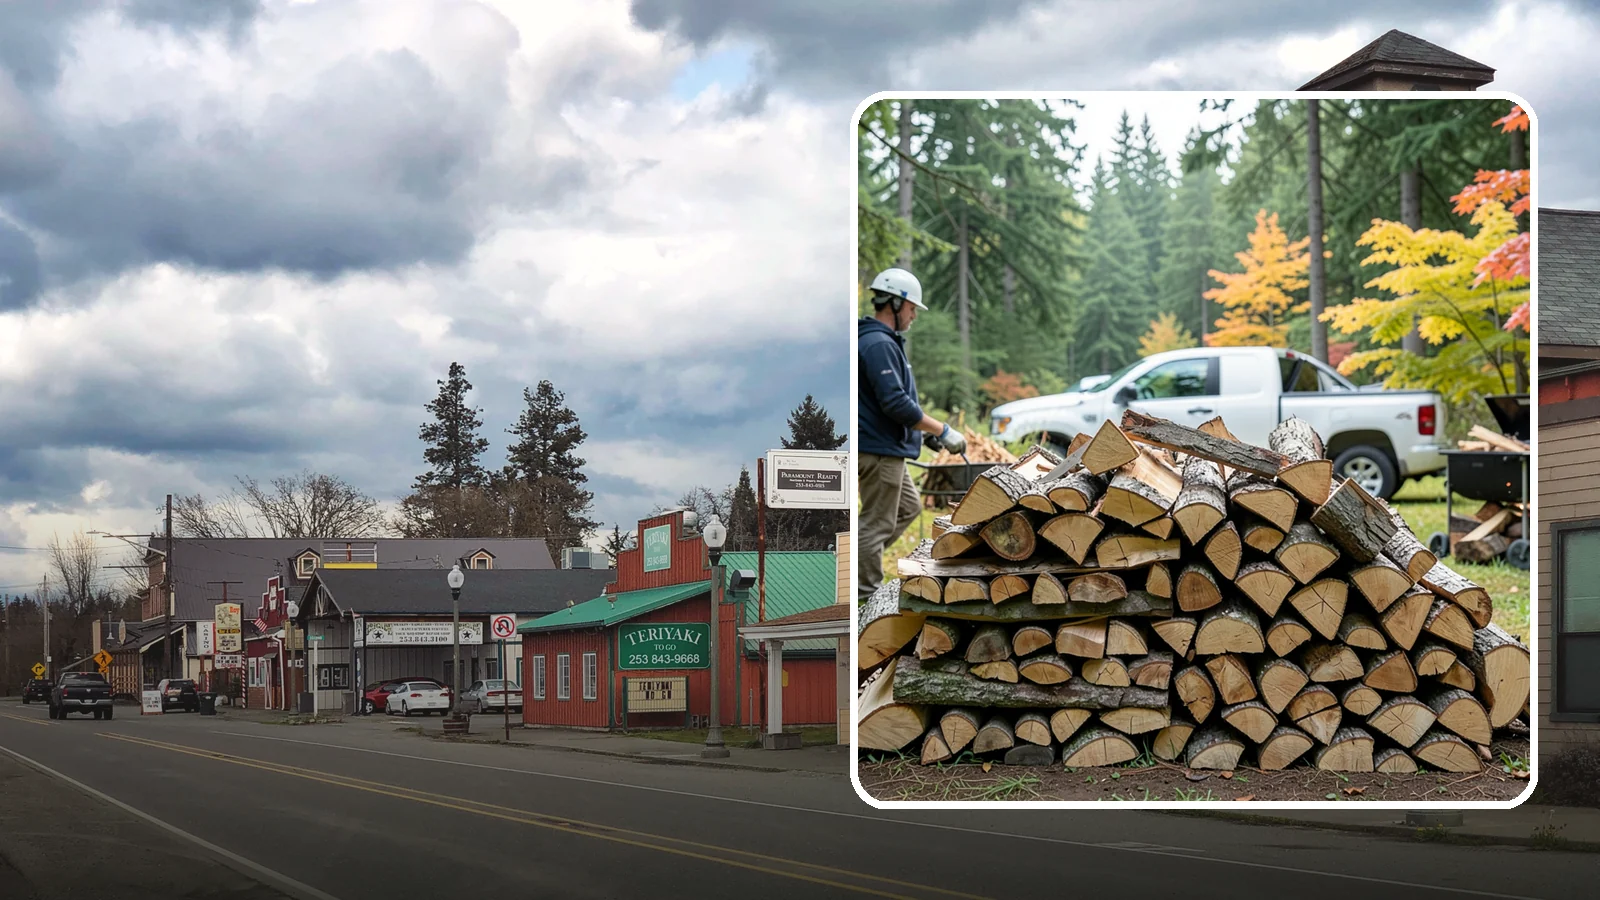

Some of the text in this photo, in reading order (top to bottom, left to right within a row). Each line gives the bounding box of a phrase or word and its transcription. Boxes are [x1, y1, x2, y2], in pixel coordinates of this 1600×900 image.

[817, 472, 839, 480] REALTY
[625, 627, 702, 646] TERIYAKI
[654, 643, 677, 651] TO GO
[629, 653, 700, 665] 253 843-9668
